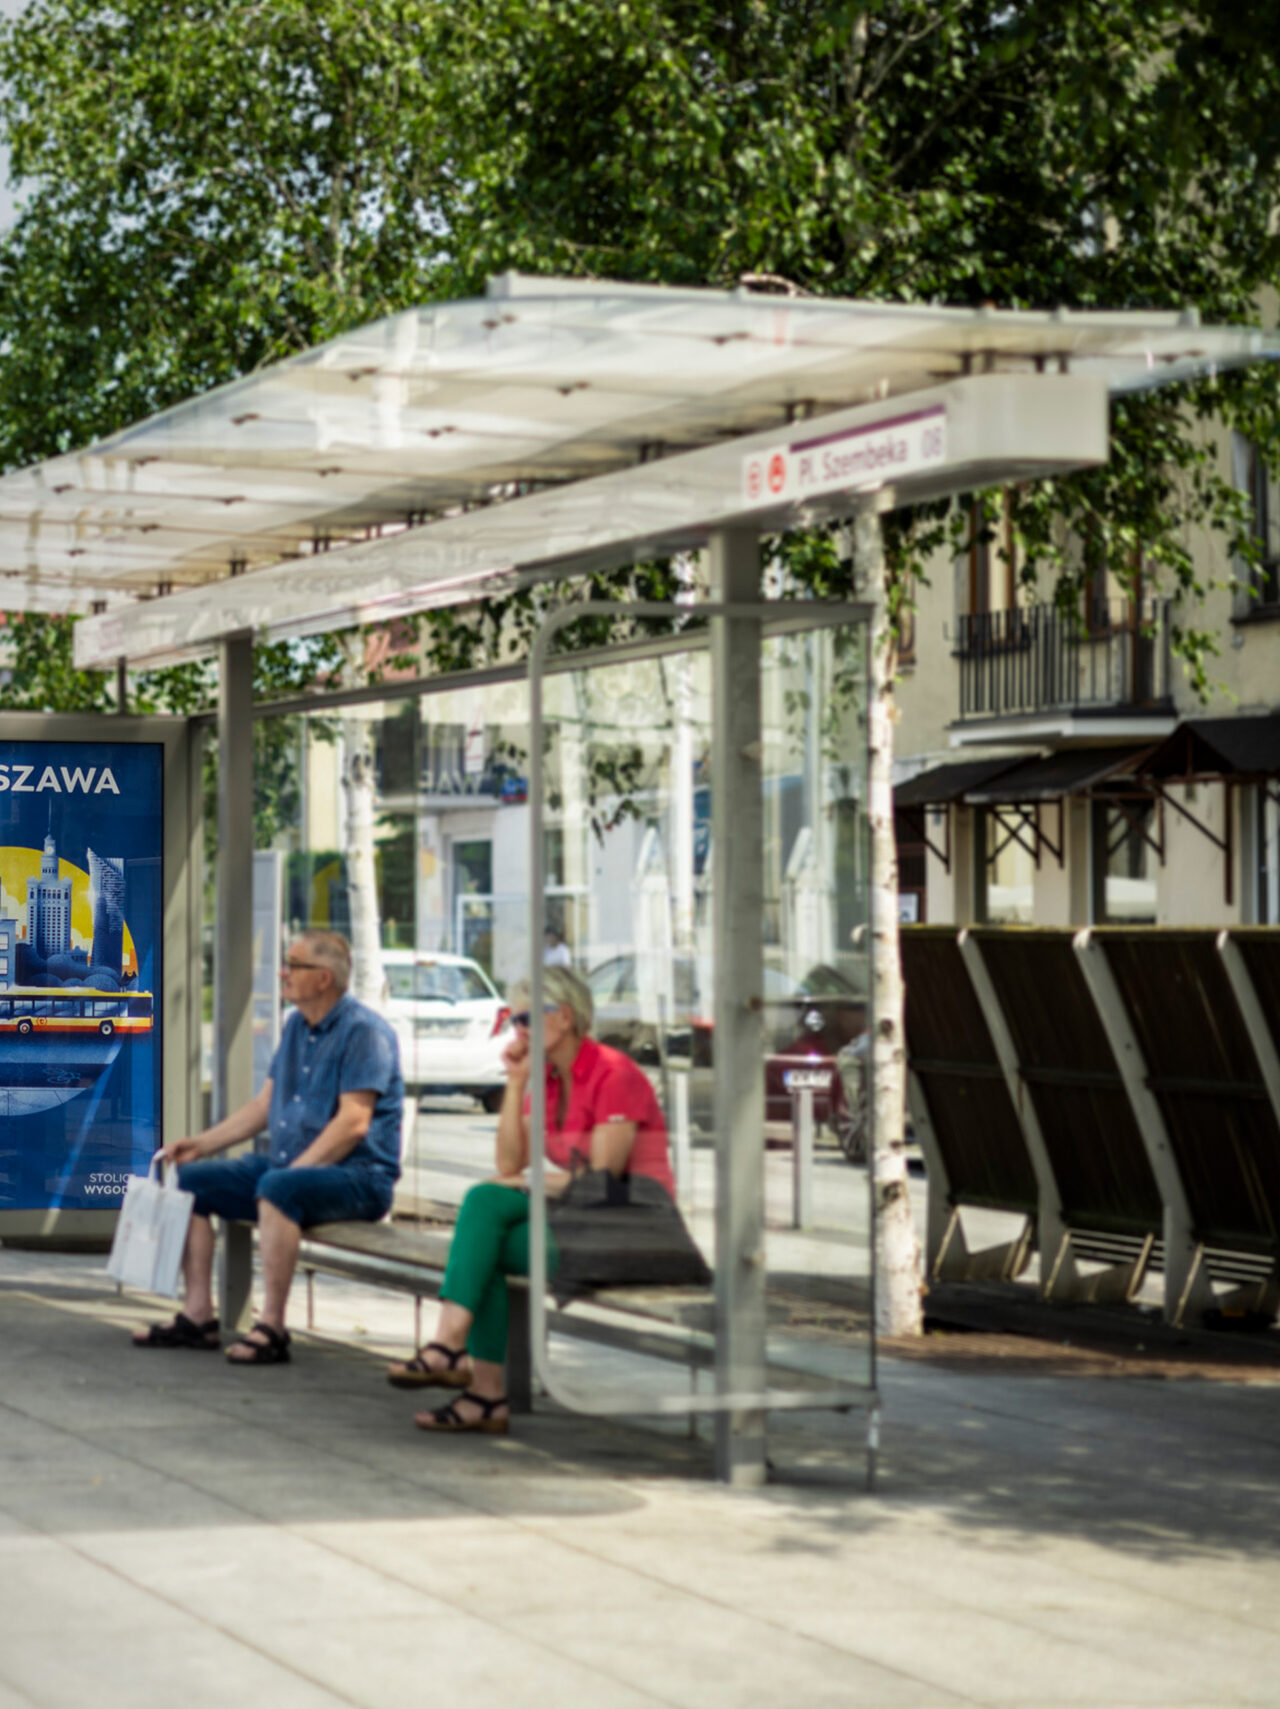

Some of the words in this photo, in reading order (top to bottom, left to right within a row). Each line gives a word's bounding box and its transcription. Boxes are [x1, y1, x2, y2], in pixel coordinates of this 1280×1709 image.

[822, 435, 907, 481] Szembeka
[90, 1173, 128, 1183] STOLIC
[84, 1185, 127, 1195] WYGOD
